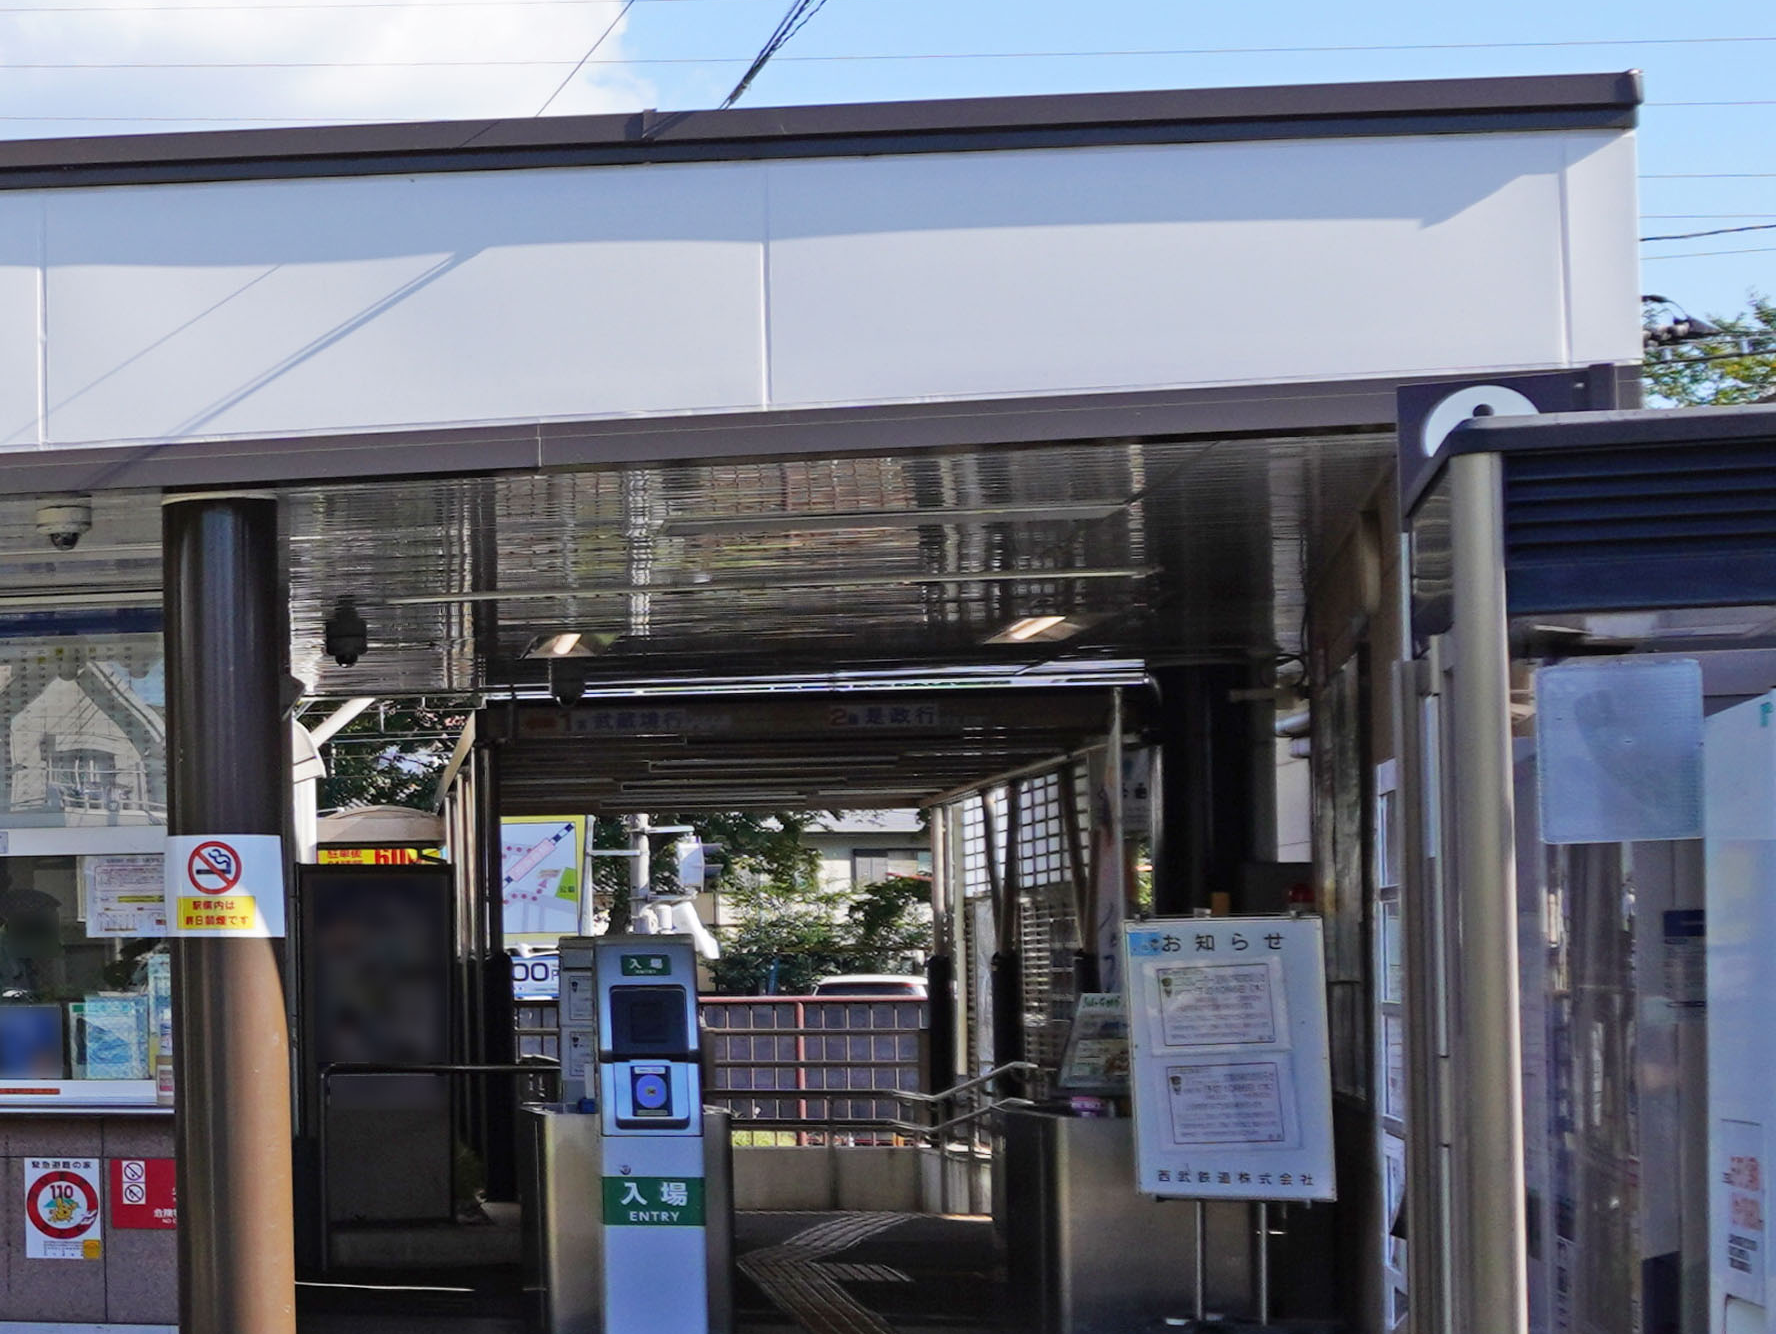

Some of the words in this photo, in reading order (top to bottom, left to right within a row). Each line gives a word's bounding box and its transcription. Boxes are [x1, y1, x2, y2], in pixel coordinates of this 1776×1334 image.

[193, 900, 235, 911] 駅構内は
[185, 915, 249, 926] 終日禁煙です
[1162, 932, 1285, 952] お知らせ
[629, 958, 663, 970] 入場
[1157, 1169, 1315, 1186] 西武鉄道株式会社
[50, 1184, 74, 1199] 110
[620, 1181, 689, 1206] 入場
[630, 1211, 680, 1221] ENTRY
